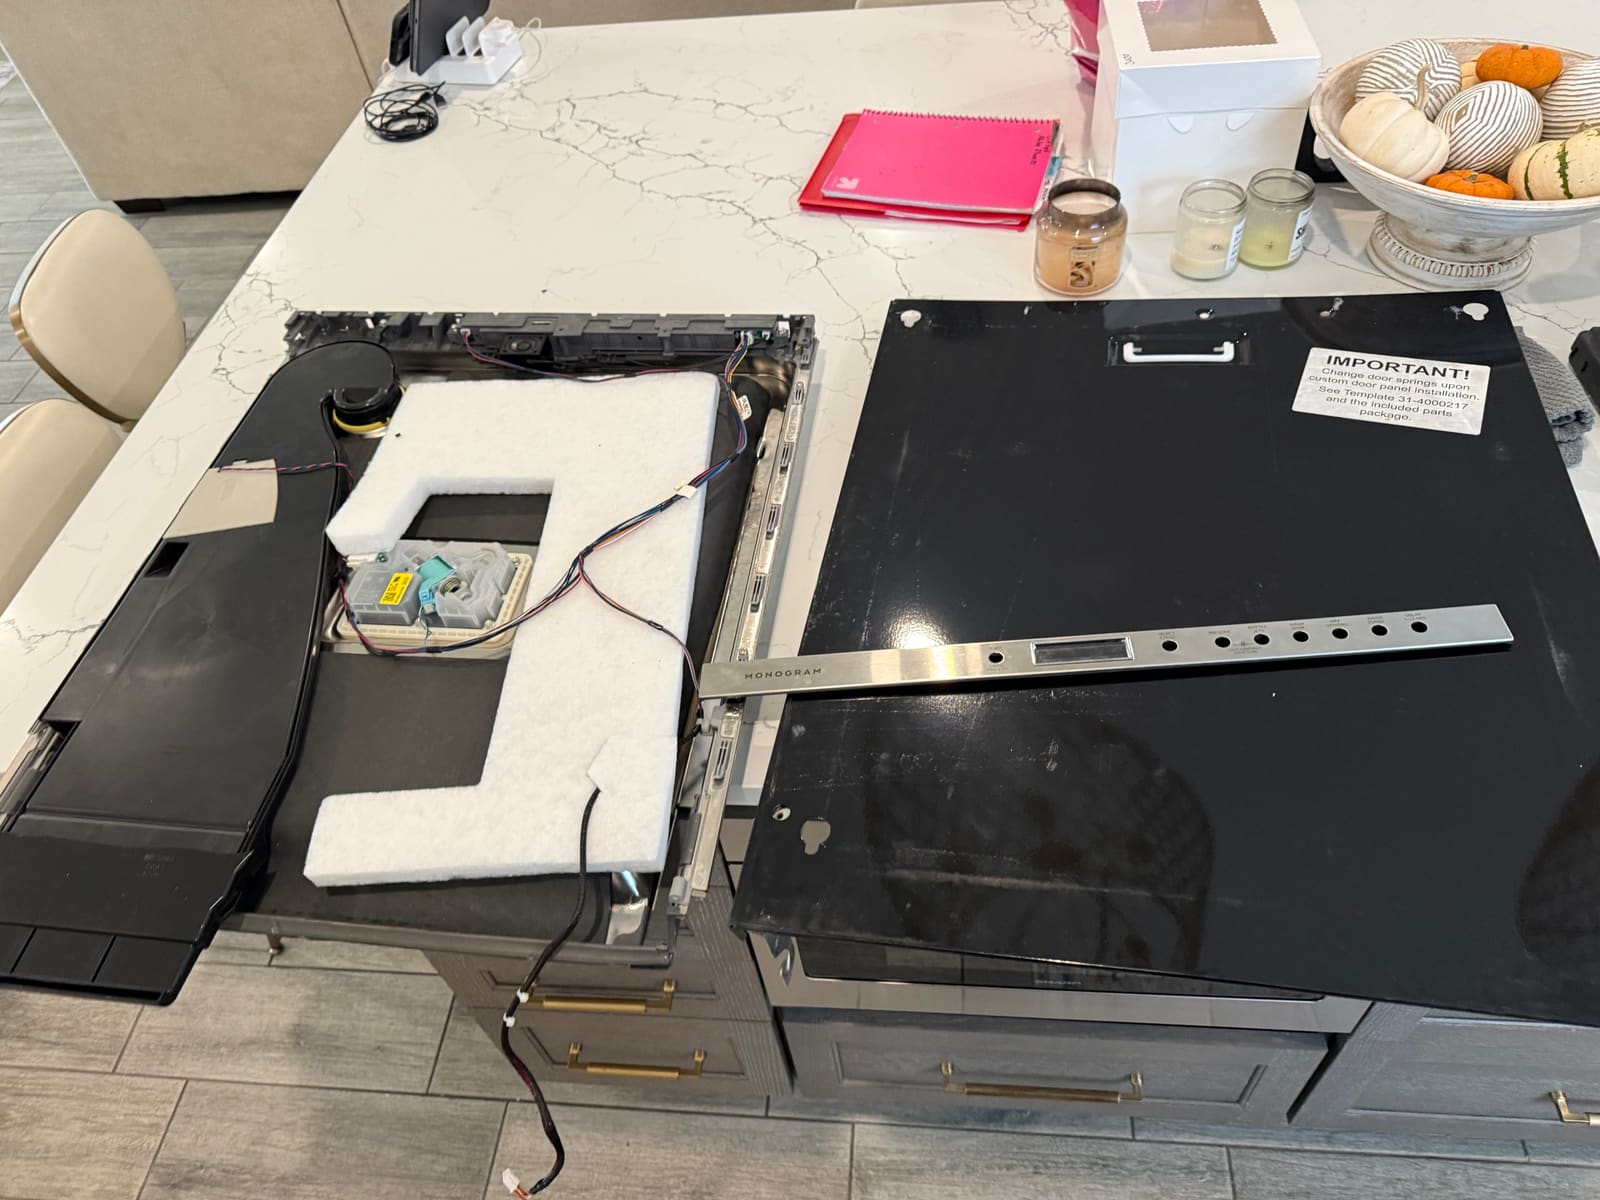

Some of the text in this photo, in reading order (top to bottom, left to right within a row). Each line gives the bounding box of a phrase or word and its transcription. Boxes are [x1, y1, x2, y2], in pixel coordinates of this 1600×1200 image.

[1321, 367, 1470, 391] Change door springs upon
[1327, 355, 1470, 380] IMPORTANT!
[1308, 375, 1480, 401] custom door panel installation.
[1318, 385, 1469, 410] See Template 31-4000217
[1325, 395, 1453, 417] and the included parts
[1359, 409, 1412, 422] package.
[744, 667, 823, 680] MONOGRAM
